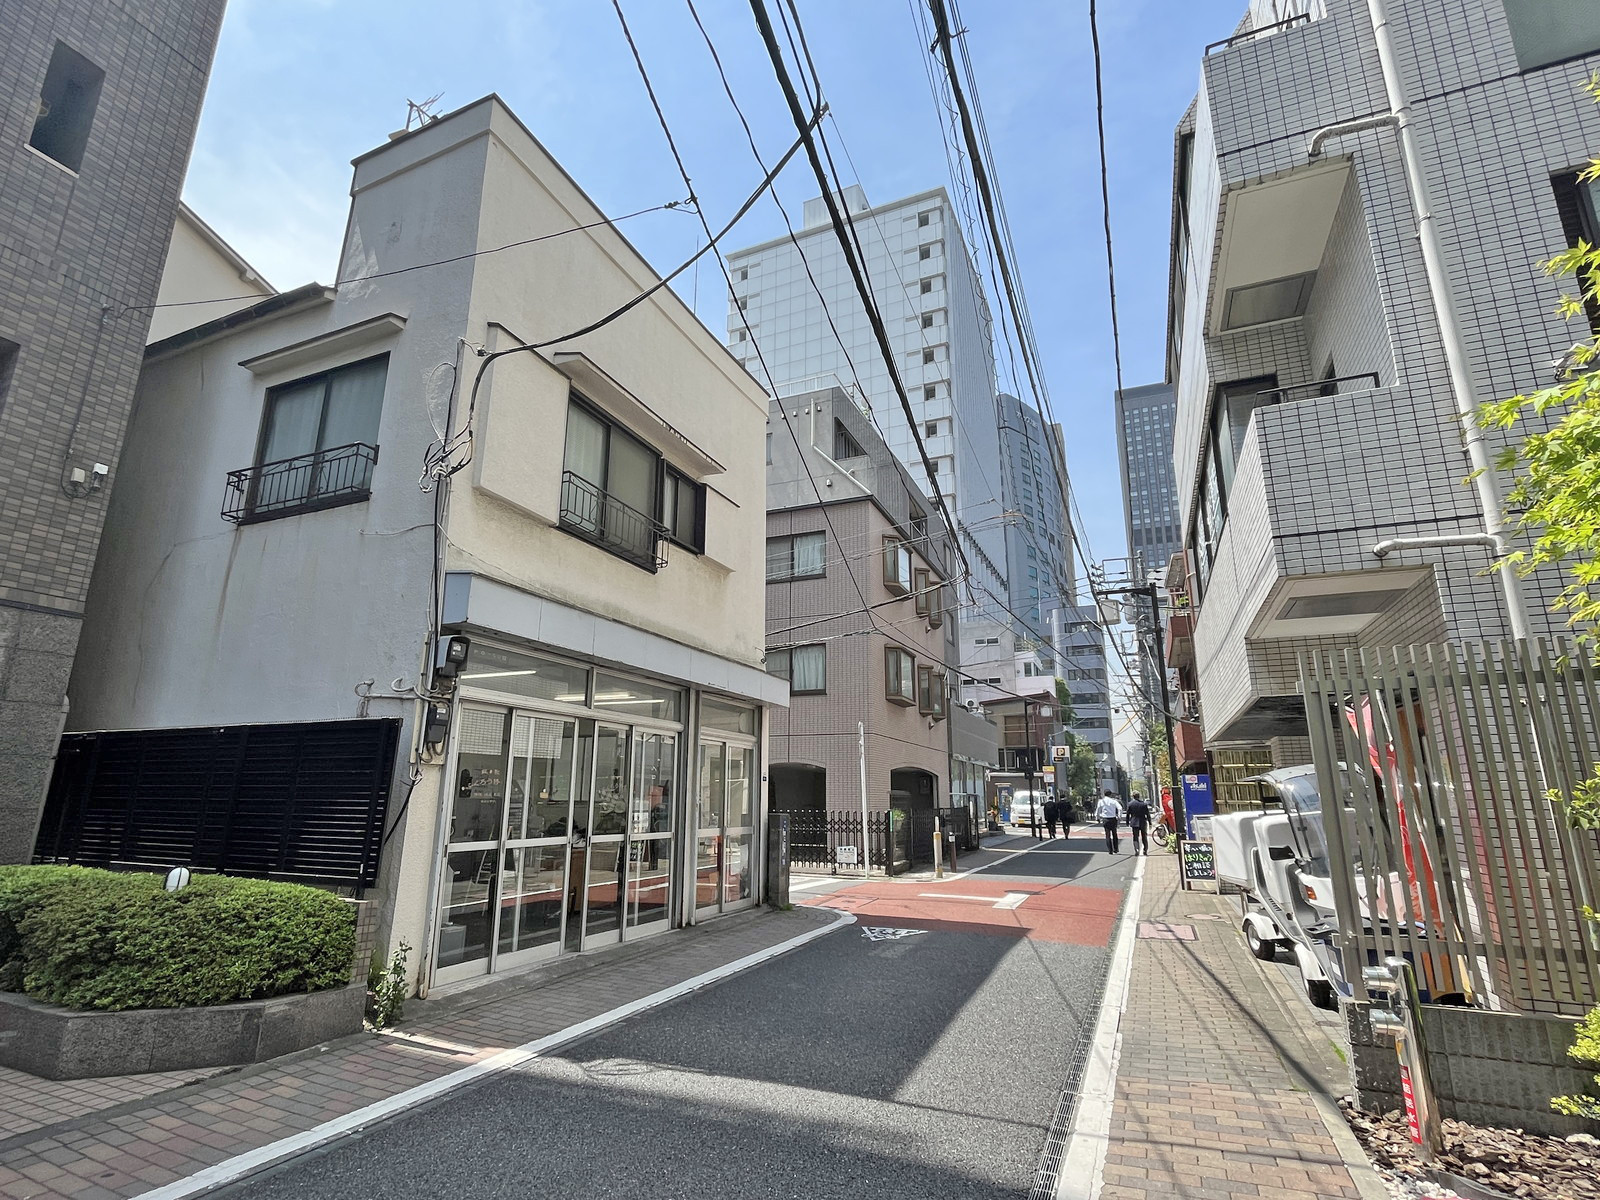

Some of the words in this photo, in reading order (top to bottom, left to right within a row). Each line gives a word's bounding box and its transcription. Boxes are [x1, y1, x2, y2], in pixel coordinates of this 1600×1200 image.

[1184, 853, 1213, 862] はりきゅう
